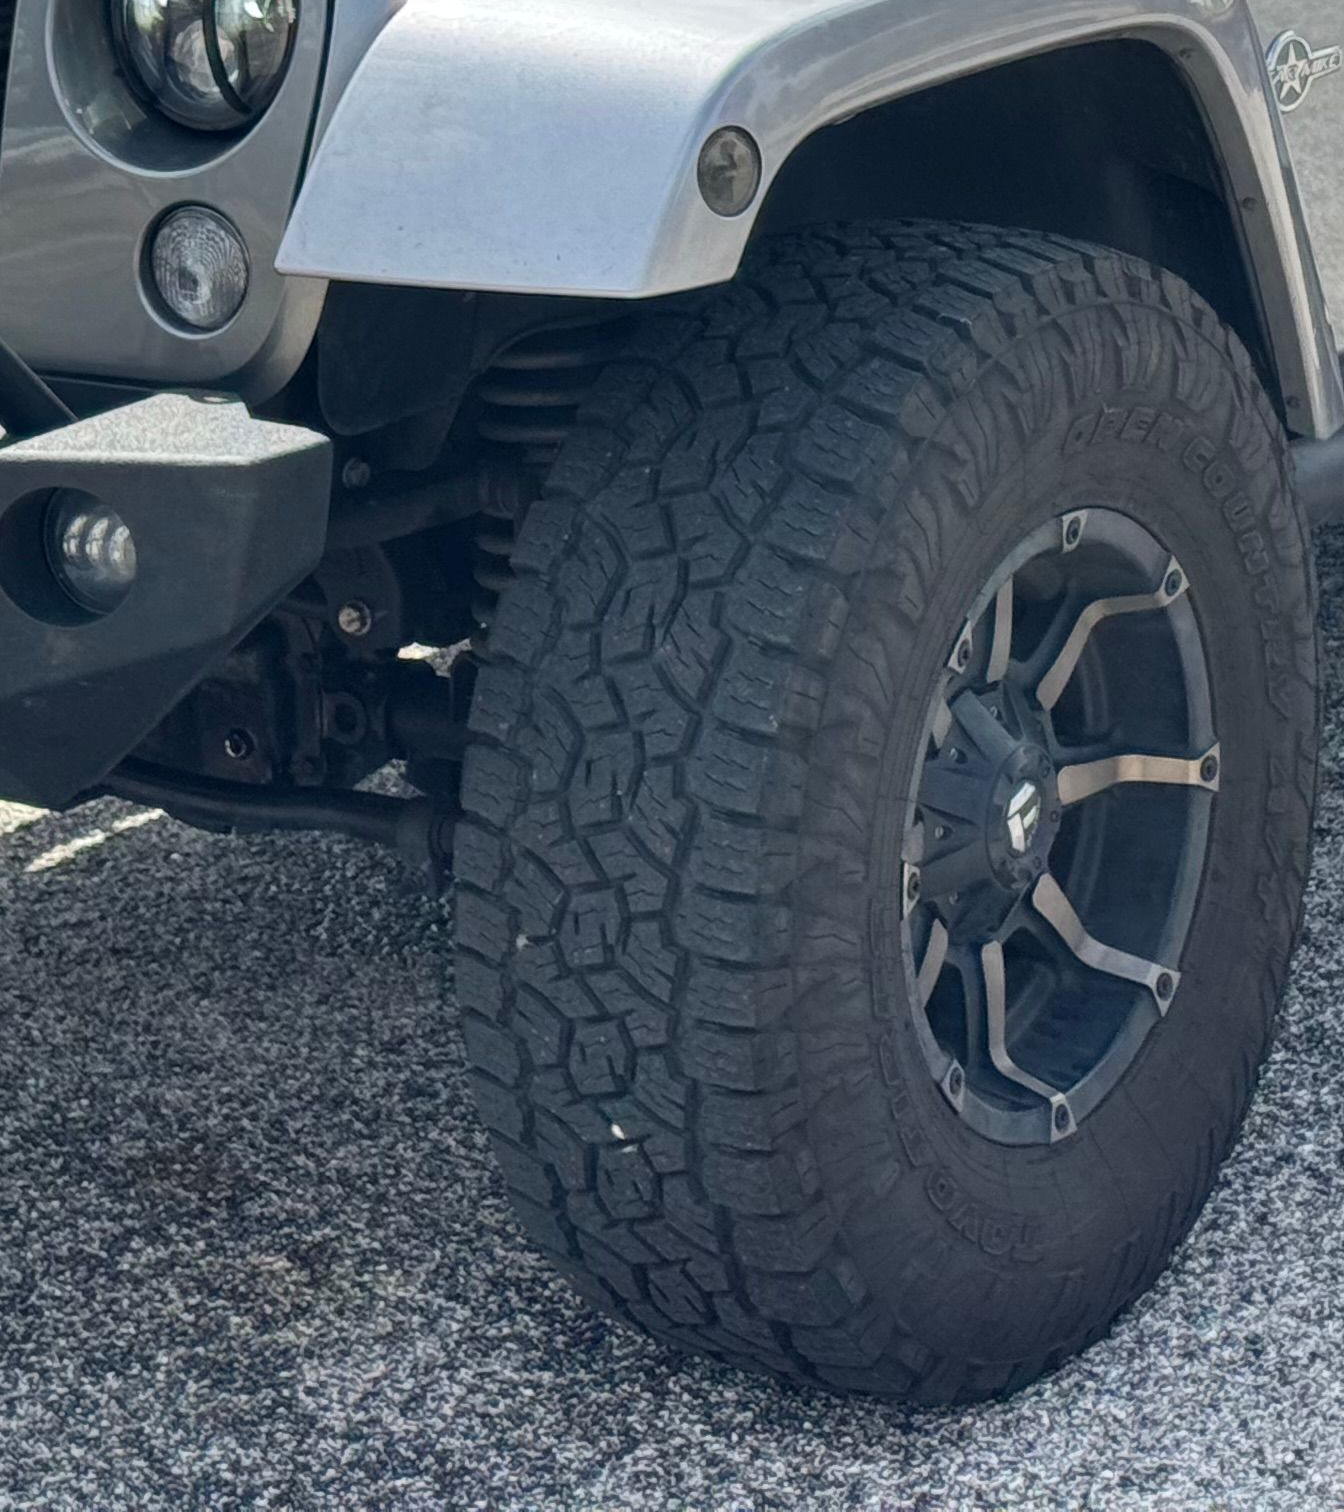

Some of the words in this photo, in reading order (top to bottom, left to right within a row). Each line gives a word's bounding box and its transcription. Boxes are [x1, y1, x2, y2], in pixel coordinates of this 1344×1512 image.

[1062, 406, 1185, 456] OPEN
[1182, 435, 1295, 720] COUNTRY
[925, 1167, 1046, 1264] TOYO
